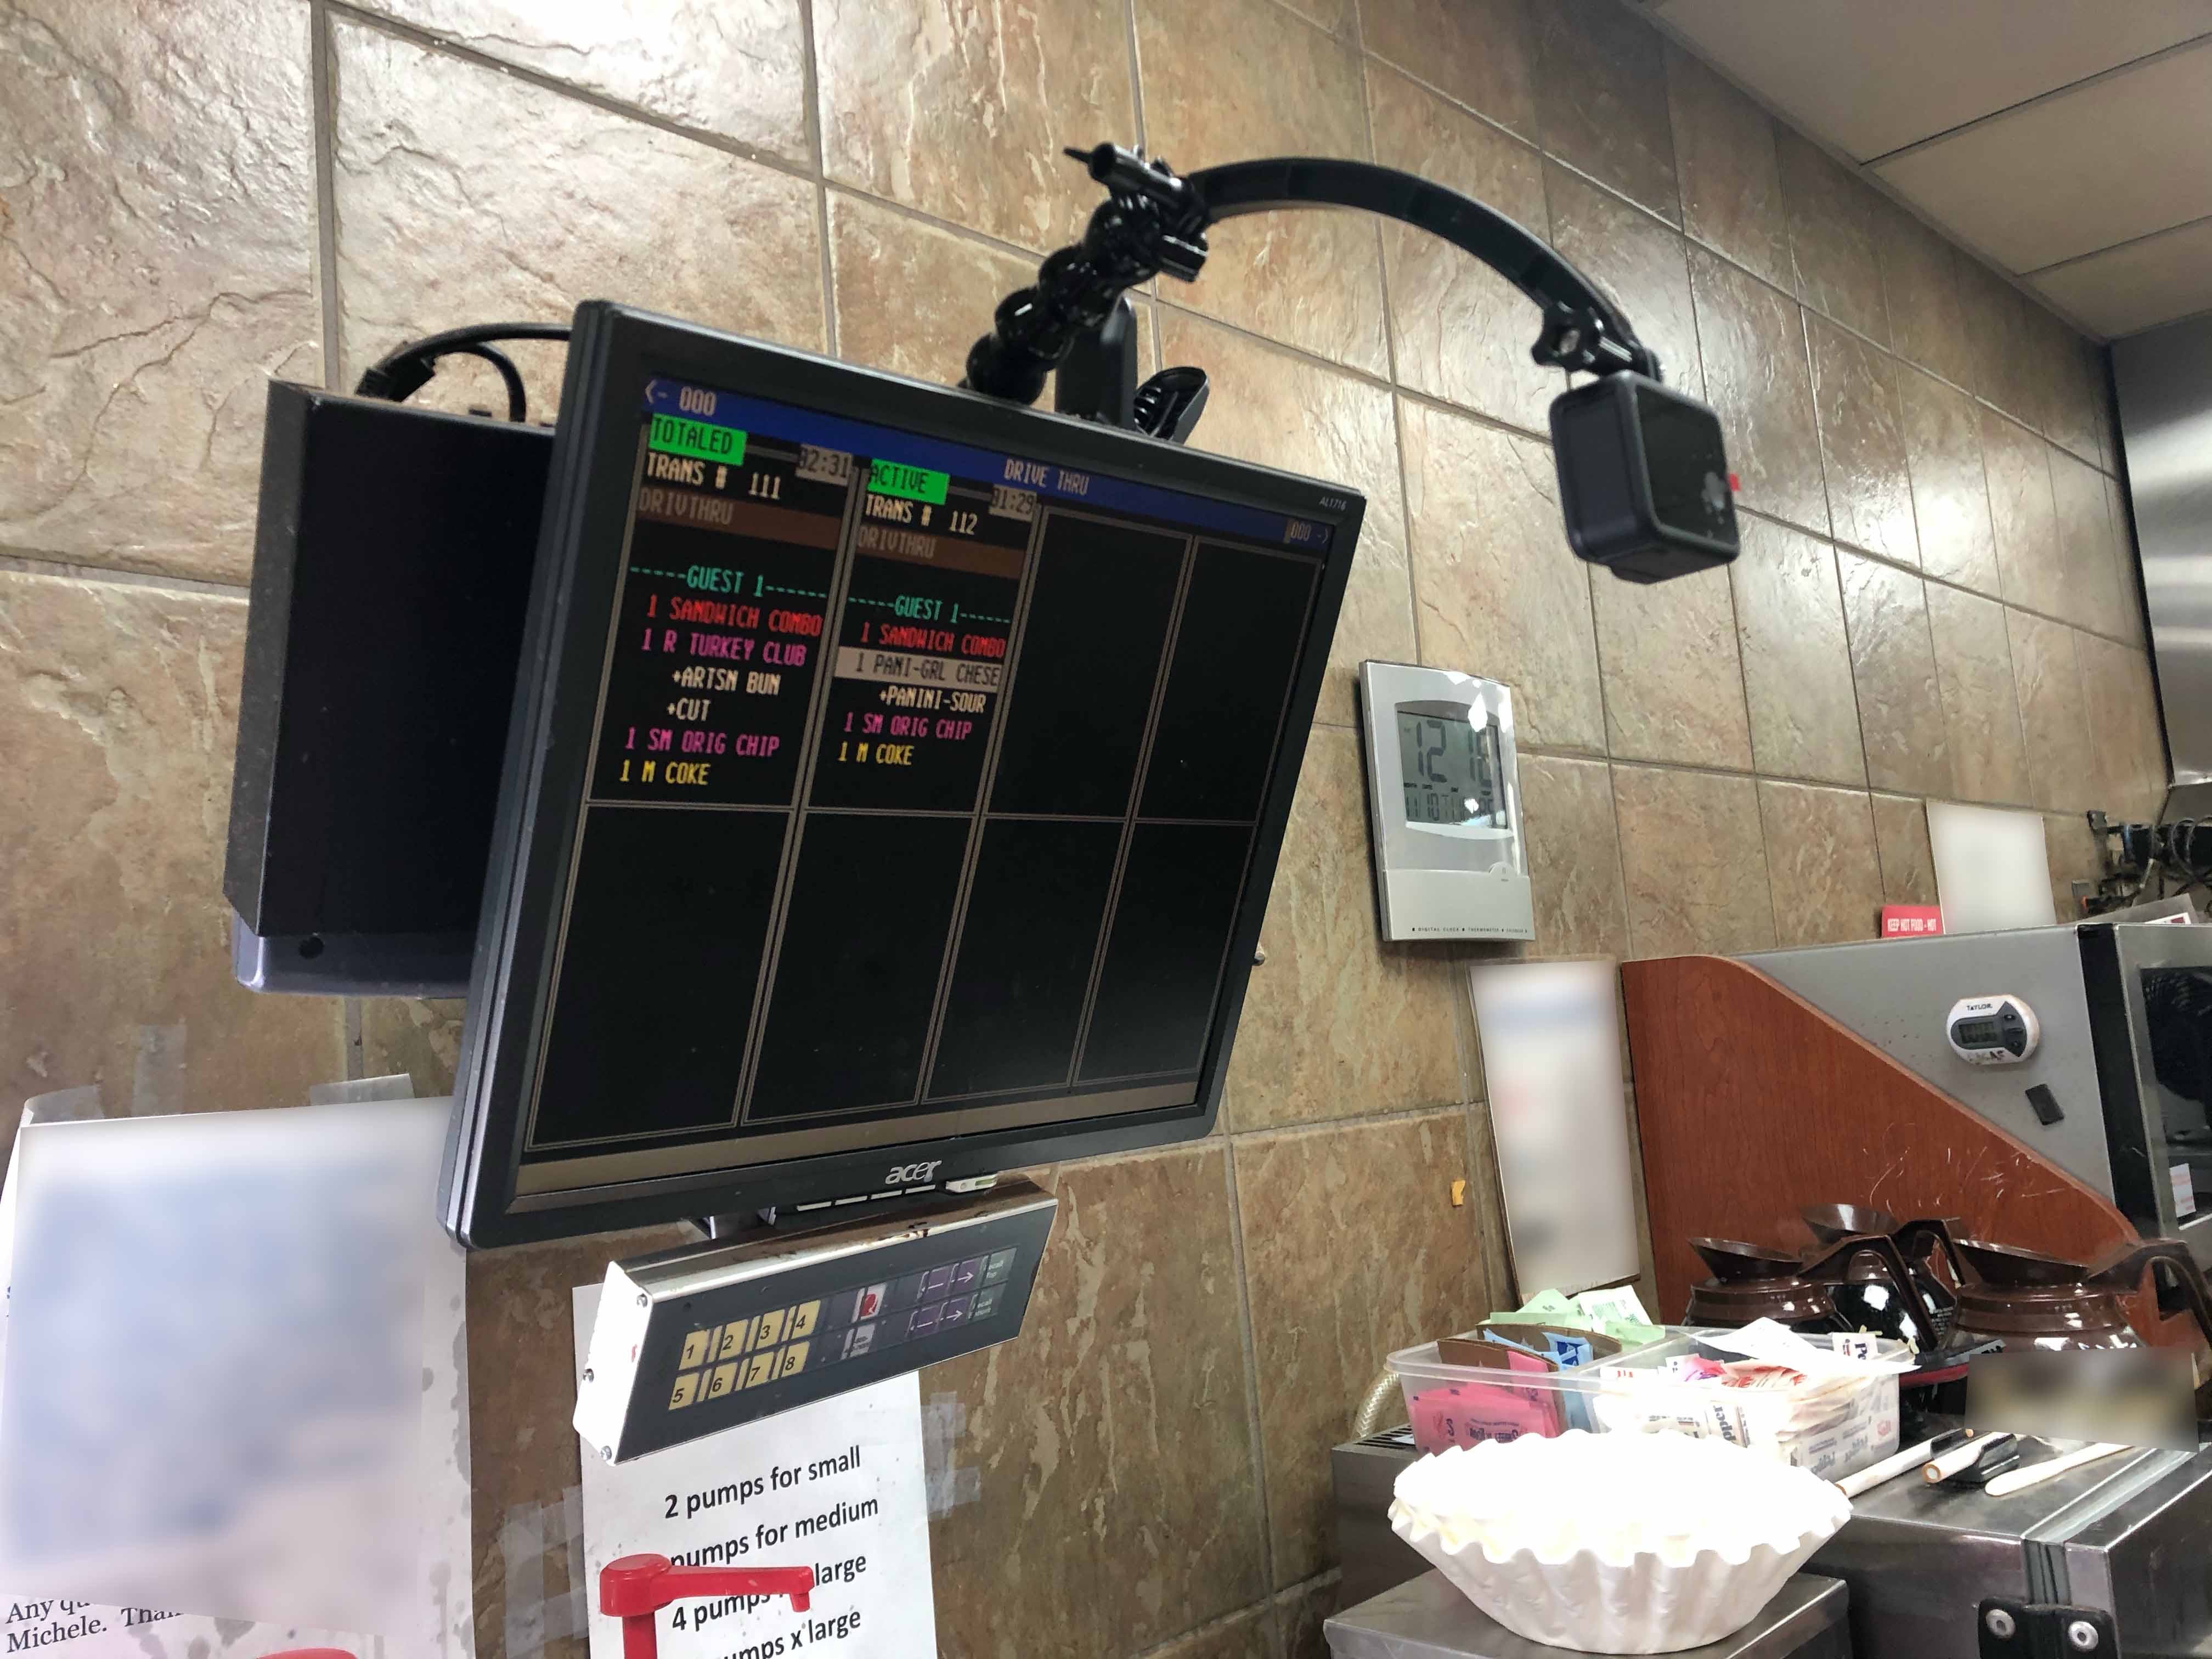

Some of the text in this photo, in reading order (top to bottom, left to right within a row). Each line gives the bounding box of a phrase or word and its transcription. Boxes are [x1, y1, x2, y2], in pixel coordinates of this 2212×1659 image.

[652, 417, 733, 454] TOTALED
[647, 452, 706, 486] TRANS
[748, 472, 781, 500] 111
[870, 464, 929, 493] ACTIVE
[1004, 458, 1090, 495] DRIVE THRU
[866, 494, 913, 523] TRANS
[949, 510, 978, 535] 112
[647, 594, 823, 636] 1 SANDWICH COMBO
[641, 628, 807, 667] 1 R TURKEY CLUB
[861, 622, 1006, 658] 1 SANDWICH COMBO
[746, 672, 781, 695] BUN
[856, 653, 1001, 686] 1 PANI-GRL CHESE
[844, 712, 972, 740] 1 SM ORIG CHIP
[625, 727, 780, 757] 1 SM ORIG CHIP
[838, 741, 915, 765] 1 M COKE
[620, 759, 710, 785] 1 M COKE
[1888, 918, 1900, 932] KEEP
[1966, 1003, 1993, 1011] TAYLOR
[885, 1160, 943, 1184] acer
[760, 1325, 770, 1340] 3
[795, 1314, 806, 1329] 4
[686, 1345, 695, 1359] 1
[723, 1335, 733, 1351] 2
[751, 1367, 760, 1381] 7
[785, 1357, 795, 1370] 8
[672, 1388, 684, 1403] 5
[713, 1378, 723, 1392] 6
[665, 1444, 861, 1519] 2 pumps for small
[755, 1525, 788, 1549] for
[795, 1498, 878, 1538] medium
[672, 1606, 687, 1630] 4
[815, 1555, 867, 1586] large
[5, 1600, 54, 1624] Any
[7, 1615, 107, 1653] Michele.
[723, 1611, 861, 1659] mps x large
